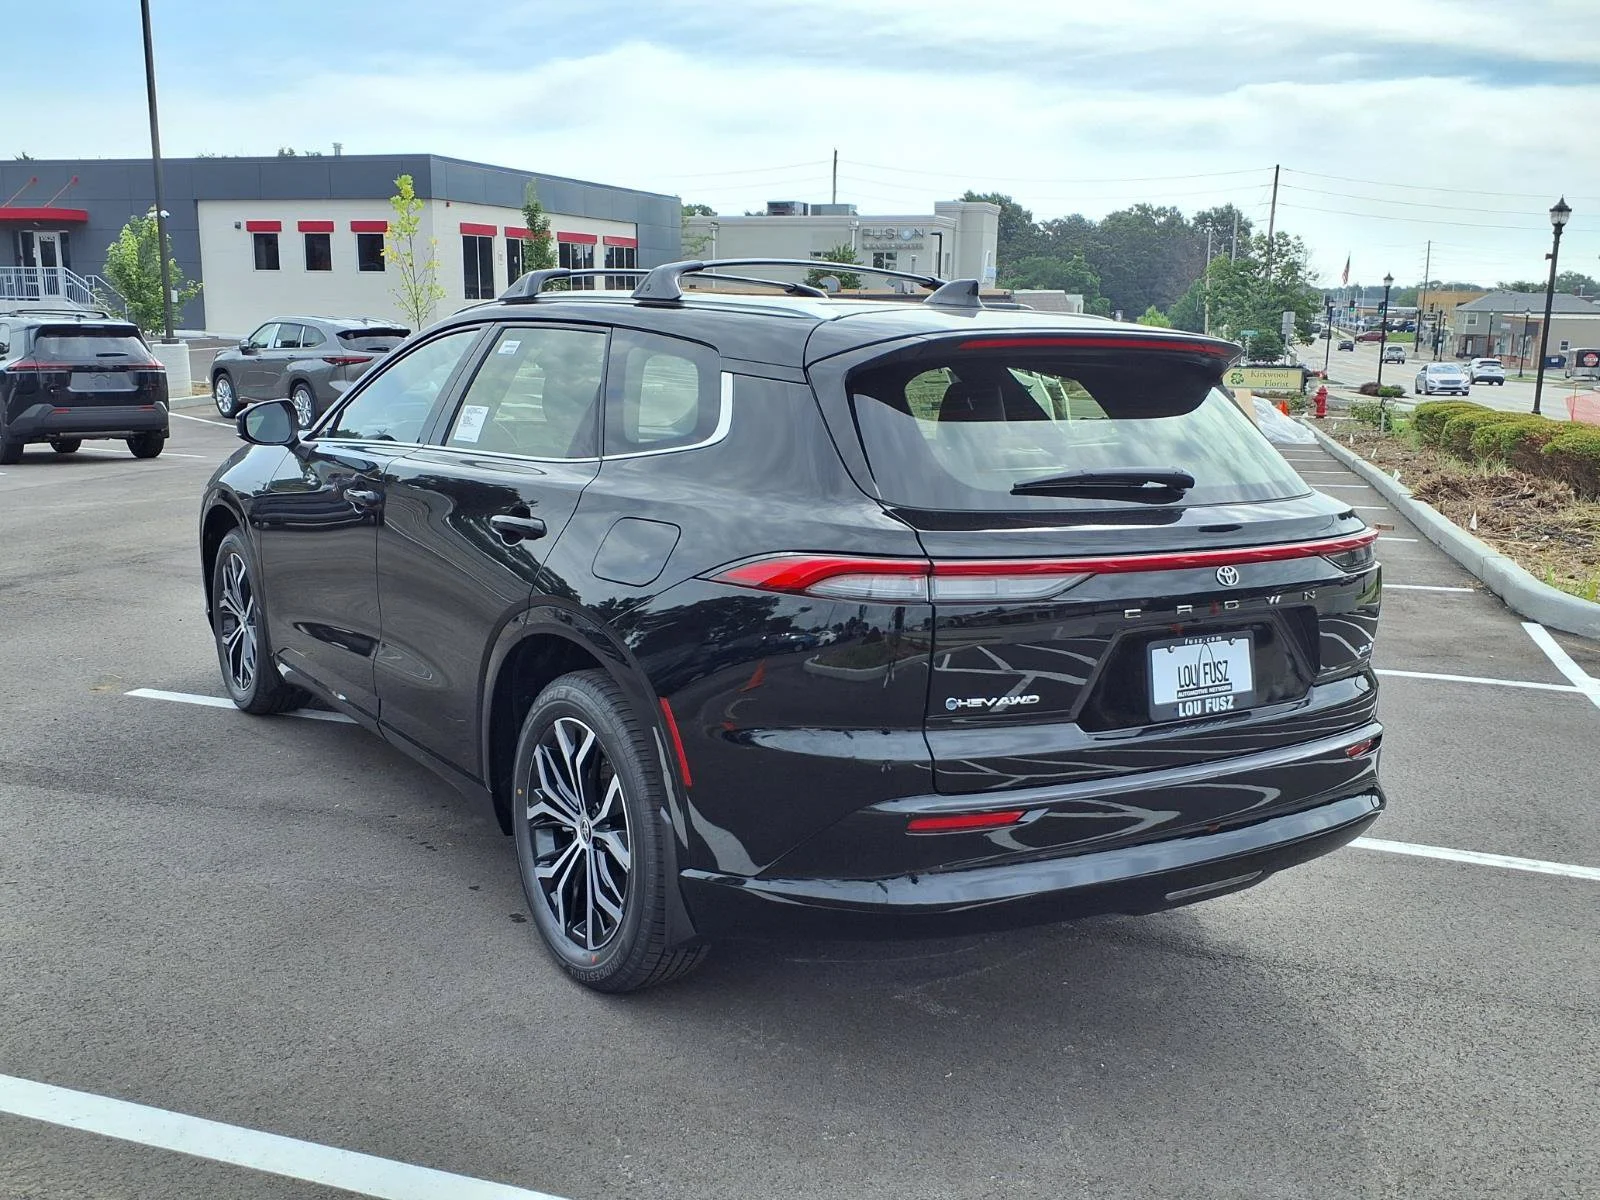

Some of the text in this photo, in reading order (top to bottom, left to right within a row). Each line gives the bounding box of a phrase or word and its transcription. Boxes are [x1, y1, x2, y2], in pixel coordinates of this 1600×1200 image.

[862, 227, 924, 240] FUSION
[1250, 370, 1289, 378] Kirkwood
[1124, 590, 1316, 618] CROWN
[1178, 660, 1229, 688] LOU FUSZ
[1178, 684, 1232, 697] AUTOMOTIVE NETWORK
[1178, 696, 1234, 717] LOU FUSZ
